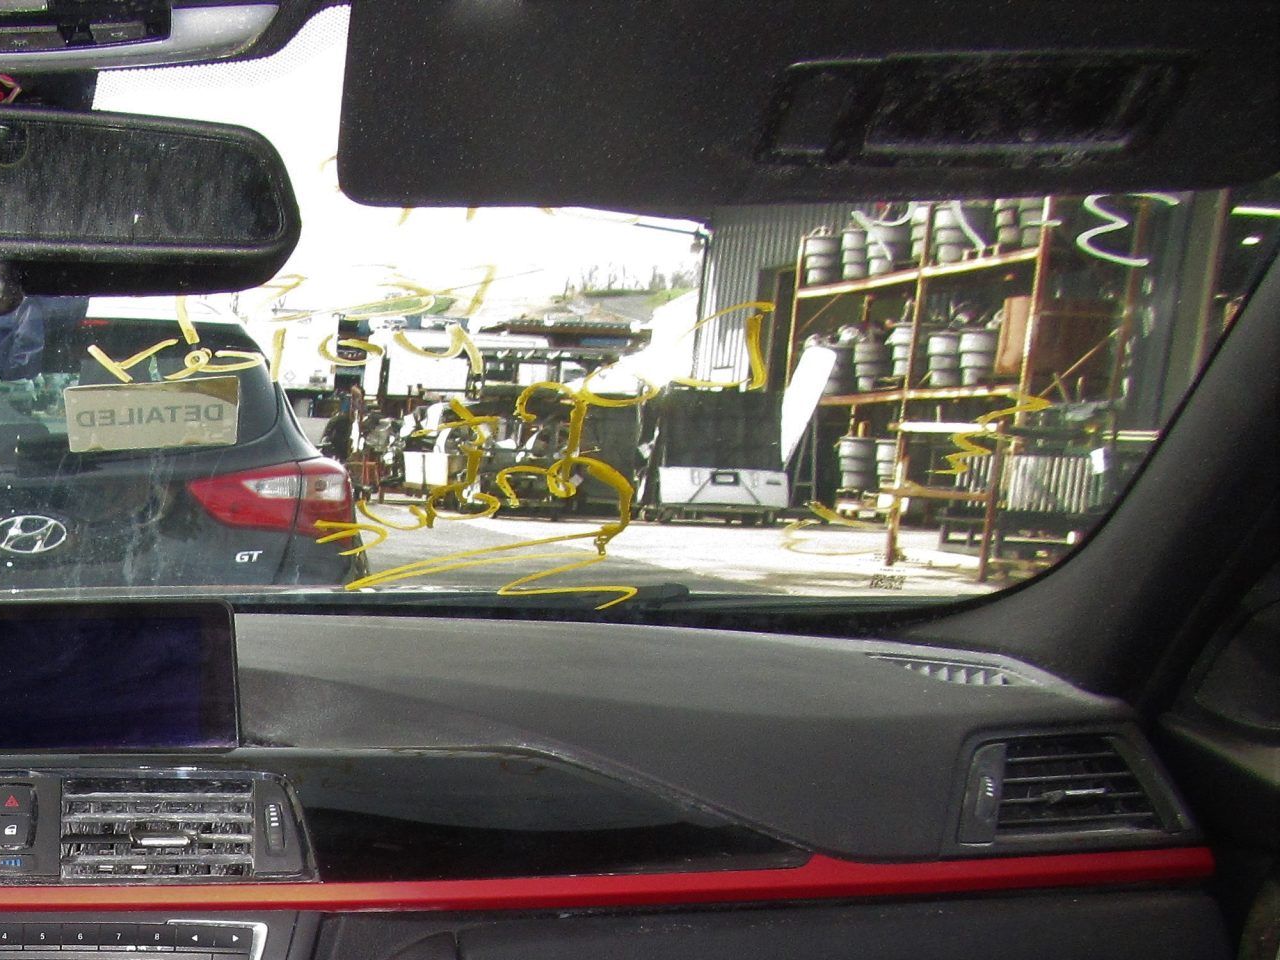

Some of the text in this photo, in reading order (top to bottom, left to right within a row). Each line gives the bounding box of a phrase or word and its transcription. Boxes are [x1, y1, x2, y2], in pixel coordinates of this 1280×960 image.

[235, 550, 263, 562] GT
[1, 932, 7, 941] 4
[40, 932, 45, 941] 5
[77, 932, 83, 941] 6
[116, 932, 122, 941] 7
[154, 932, 160, 941] 8
